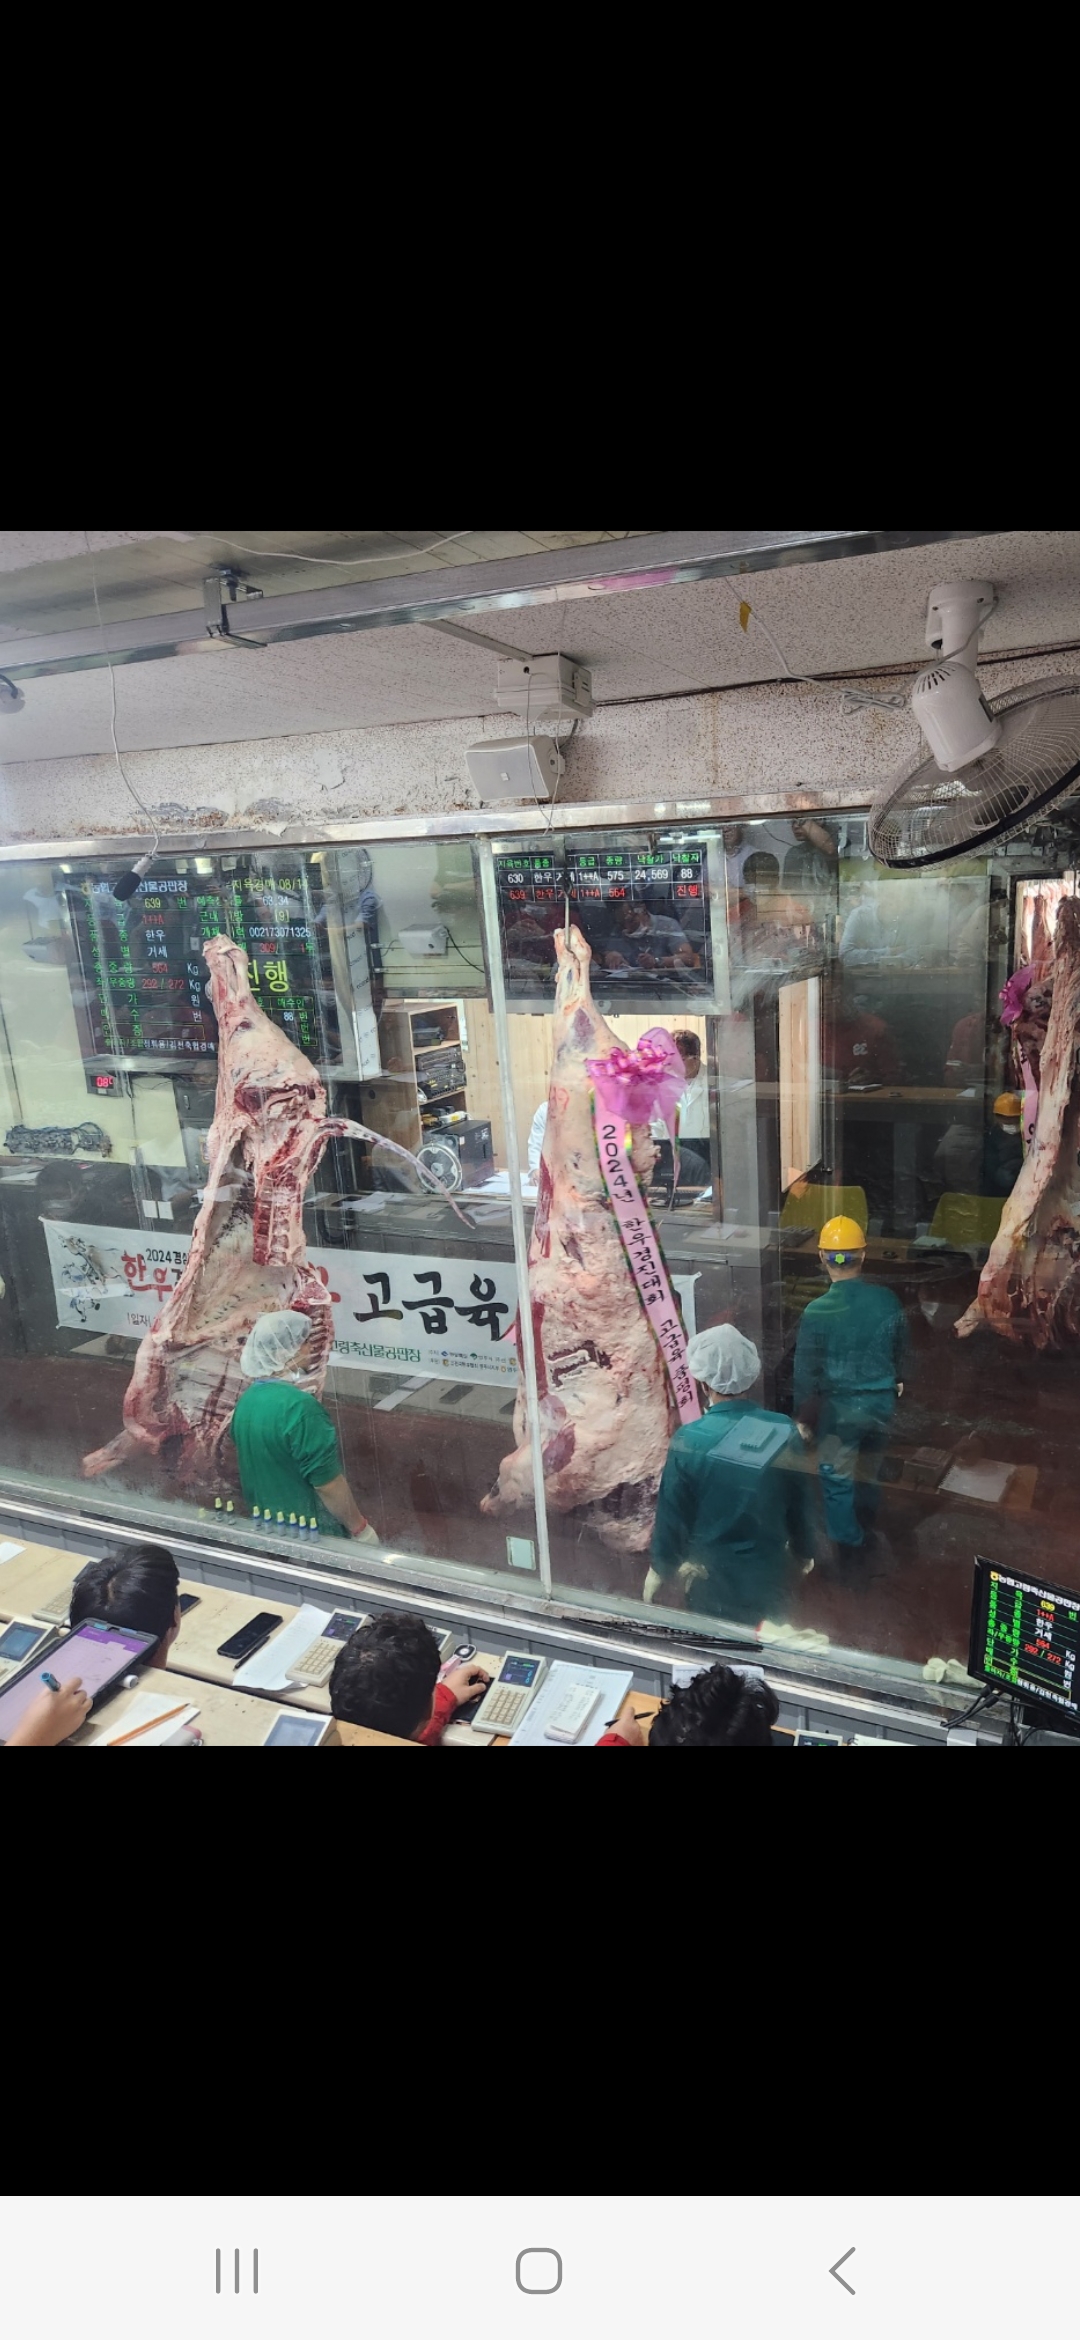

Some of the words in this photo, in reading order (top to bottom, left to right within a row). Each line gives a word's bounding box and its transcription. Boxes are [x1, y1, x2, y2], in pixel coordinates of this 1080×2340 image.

[507, 872, 524, 884] 630
[534, 871, 552, 884] 한우
[579, 870, 599, 882] 1++A
[607, 870, 624, 881] 575
[680, 867, 693, 879] 88
[509, 890, 526, 900] 639
[535, 888, 553, 900] 한우
[608, 886, 625, 898] 564
[676, 884, 698, 897] 진행
[144, 898, 161, 909] 639
[145, 929, 166, 942] 한우
[147, 945, 168, 958] 거세
[187, 962, 199, 976] Kg
[142, 978, 158, 989] 292
[168, 979, 184, 990] 272
[189, 979, 201, 992] Kg
[283, 1011, 294, 1022] 88
[602, 1124, 635, 1203] 2024년
[623, 1217, 665, 1306] 한우경진대회
[660, 1318, 686, 1364] 고급육
[146, 1248, 172, 1263] 2024
[121, 1250, 173, 1302] 한우
[353, 1271, 509, 1342] 고급육
[1065, 1650, 1076, 1662] Kg
[1065, 1660, 1075, 1672] Kg
